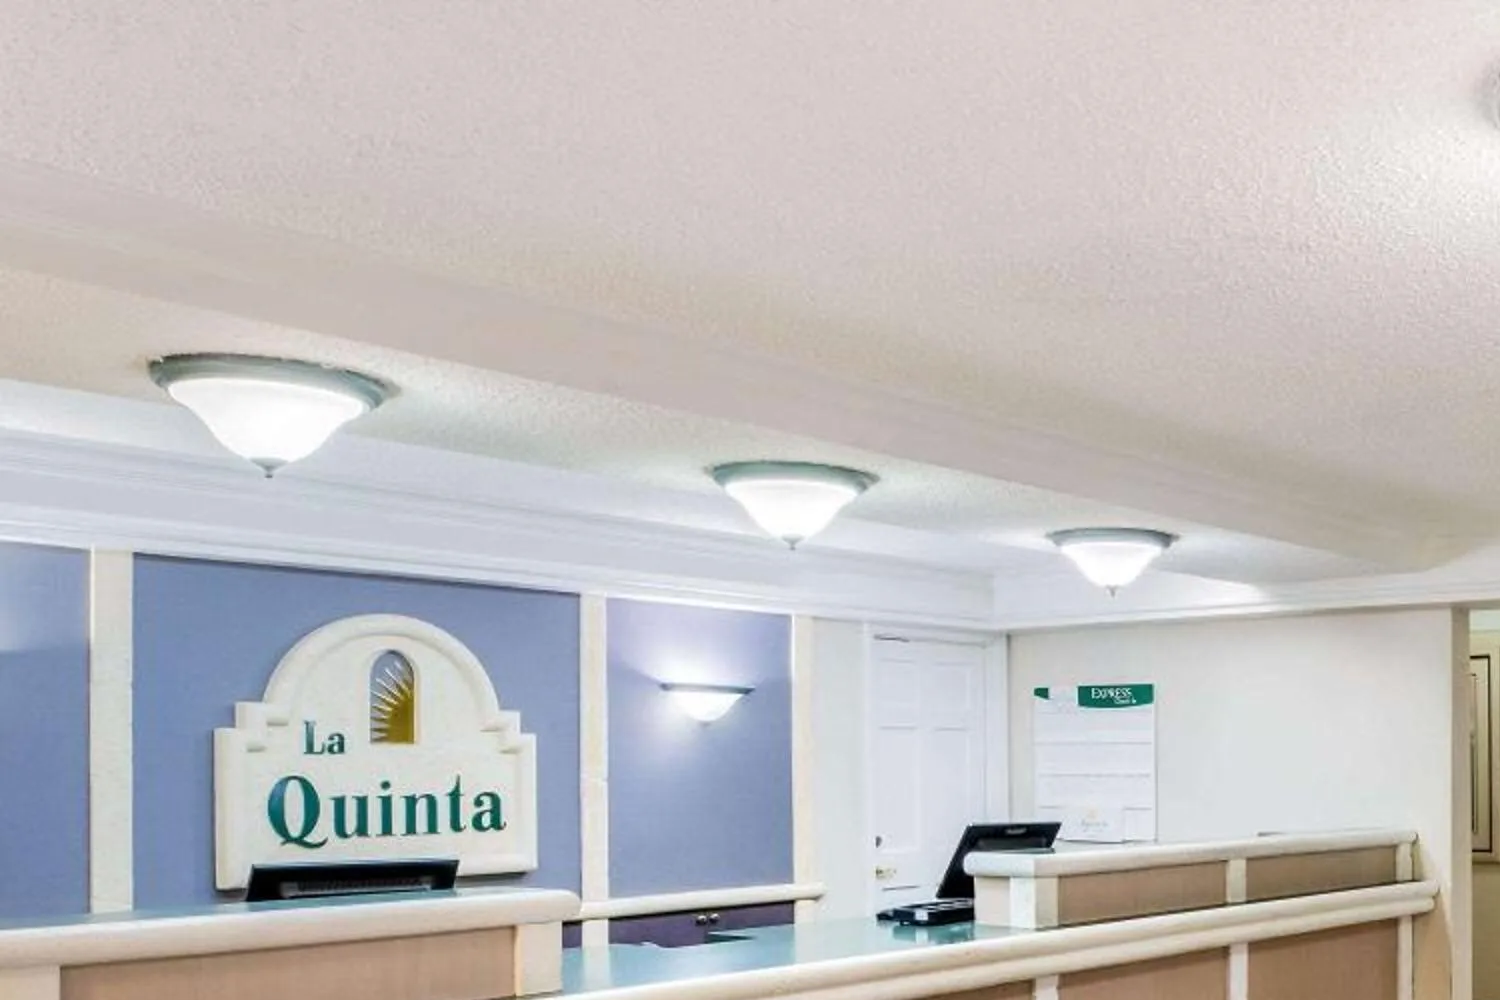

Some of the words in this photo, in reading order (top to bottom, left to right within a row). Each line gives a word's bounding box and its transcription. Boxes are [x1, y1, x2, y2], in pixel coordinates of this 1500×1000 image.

[1091, 687, 1132, 699] EXPRESS
[303, 720, 346, 755] La
[267, 774, 507, 849] Quinta
